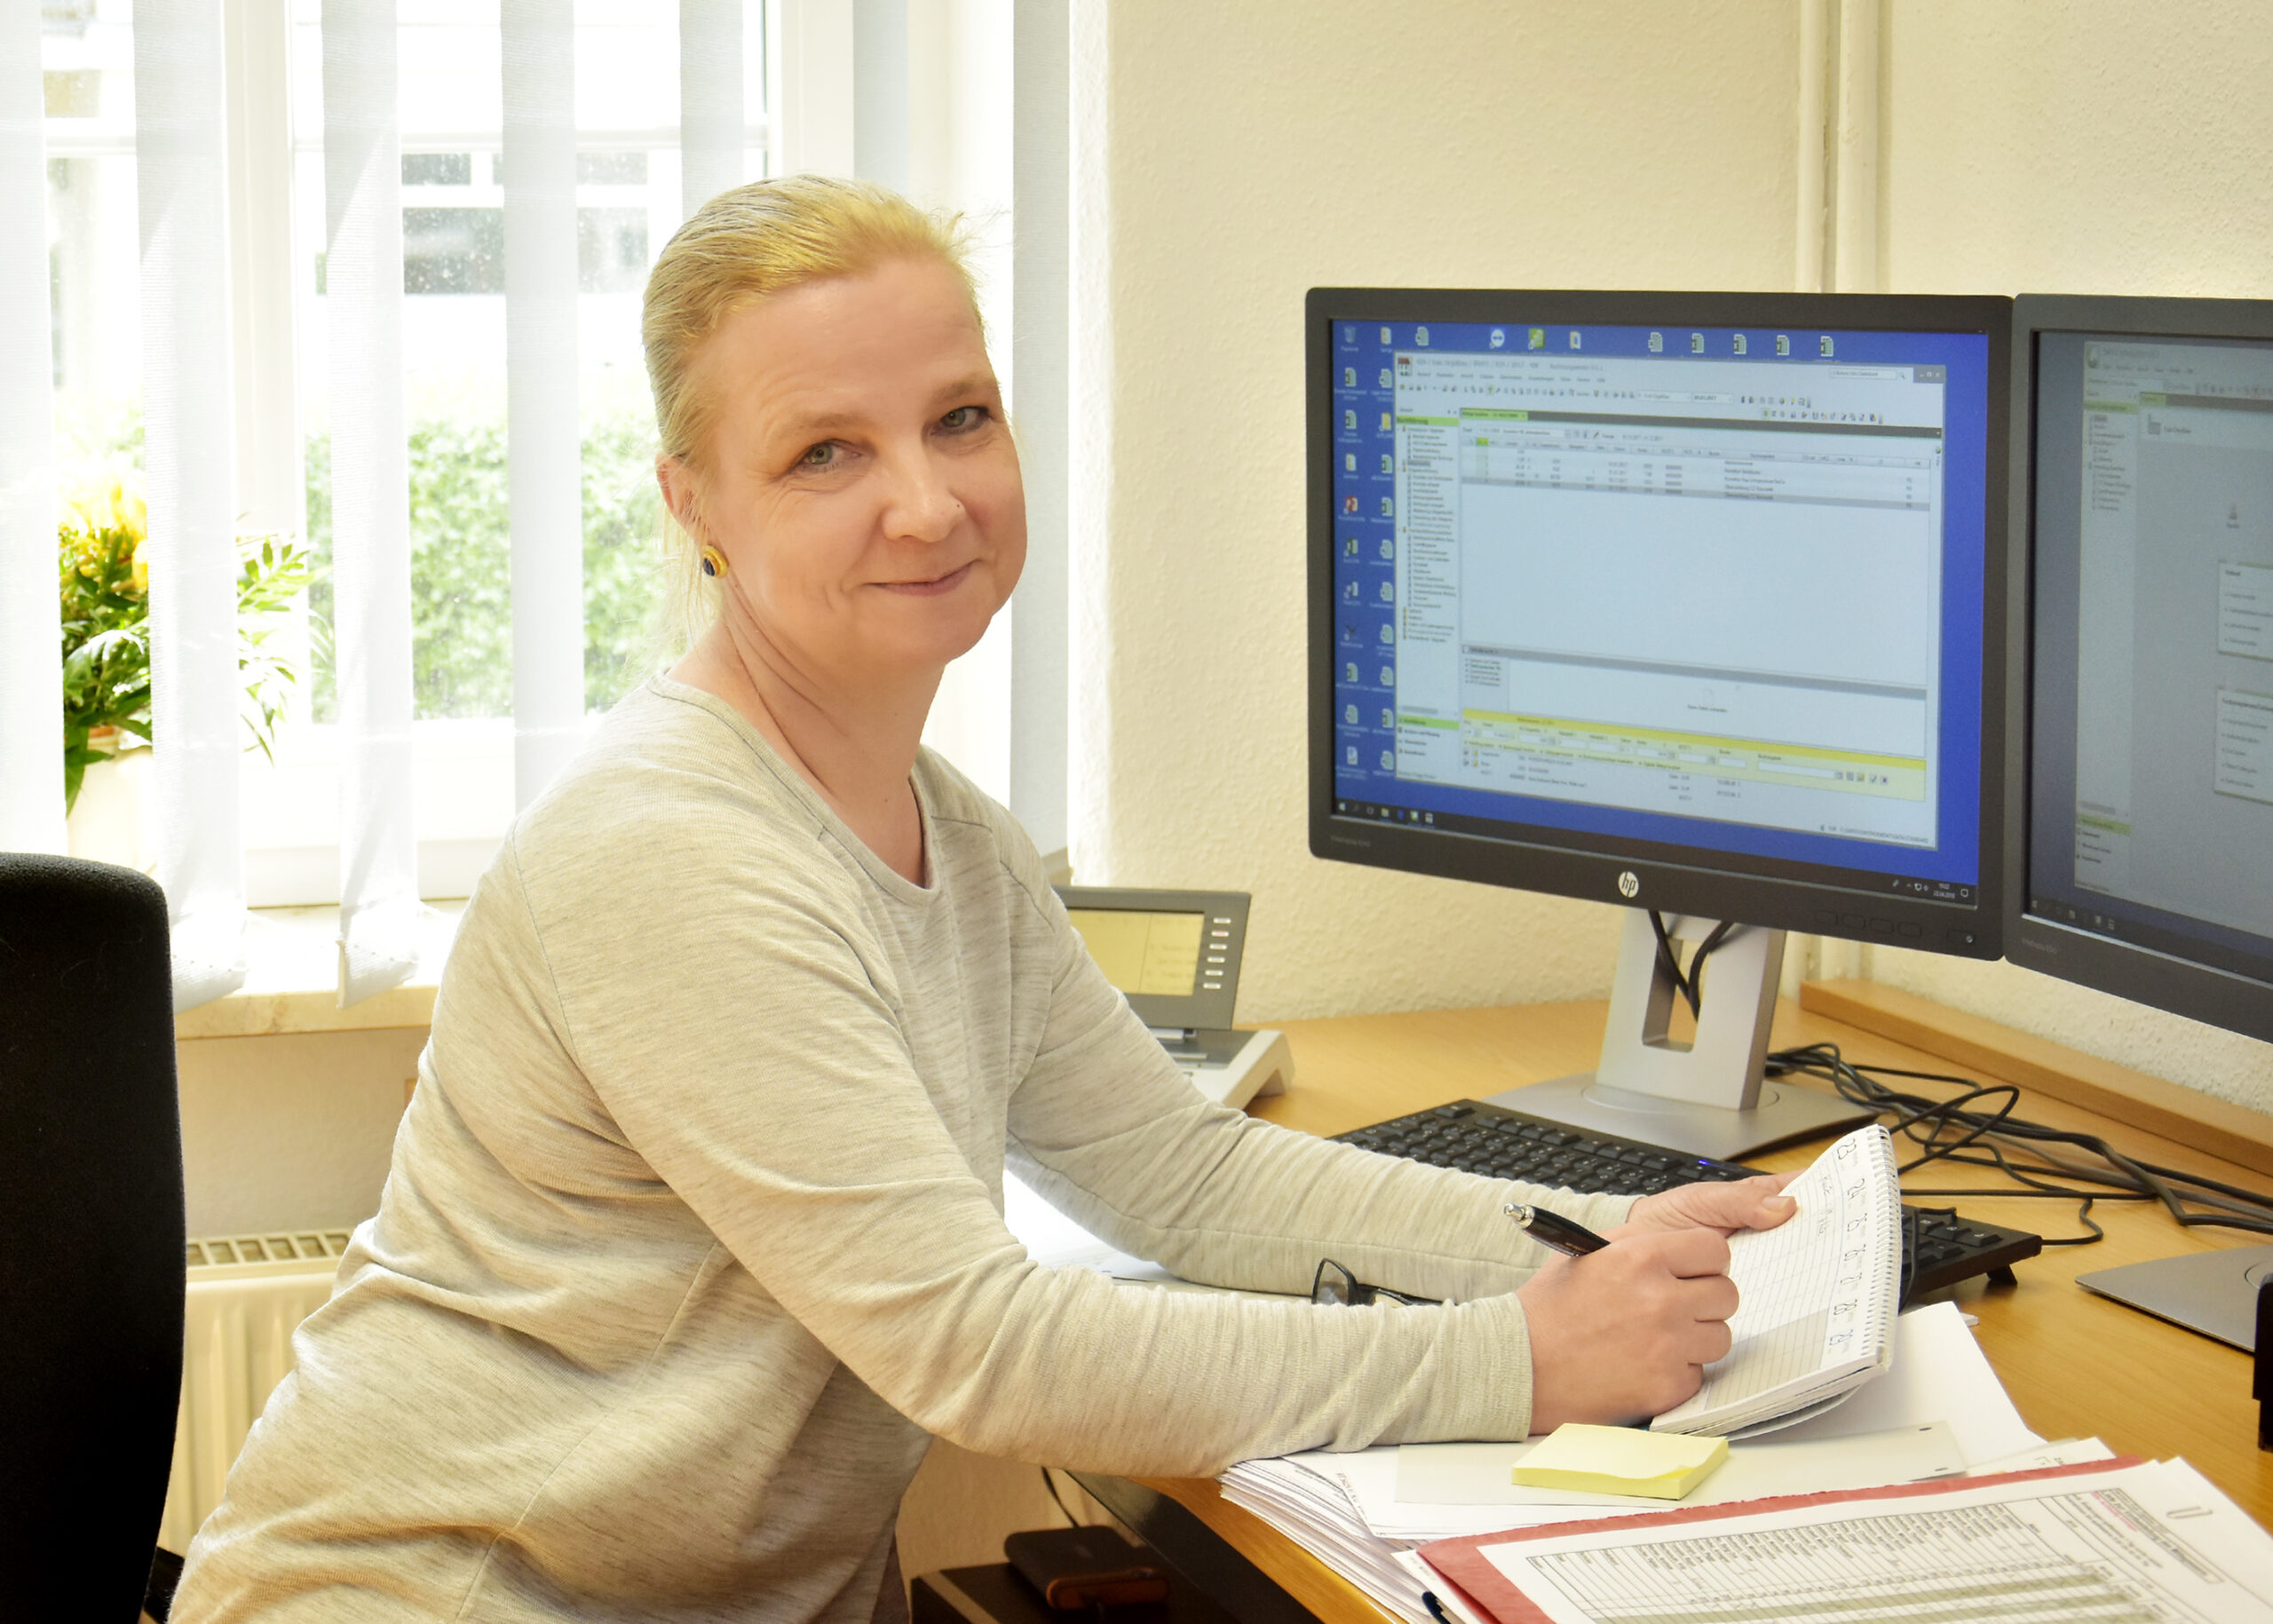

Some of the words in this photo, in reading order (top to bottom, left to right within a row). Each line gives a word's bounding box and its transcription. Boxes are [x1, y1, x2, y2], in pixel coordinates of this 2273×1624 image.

[1621, 871, 1636, 897] hp
[1837, 1138, 1857, 1161] 23
[1848, 1178, 1866, 1200] 24
[1847, 1213, 1868, 1232] 25
[1844, 1244, 1866, 1262] 26
